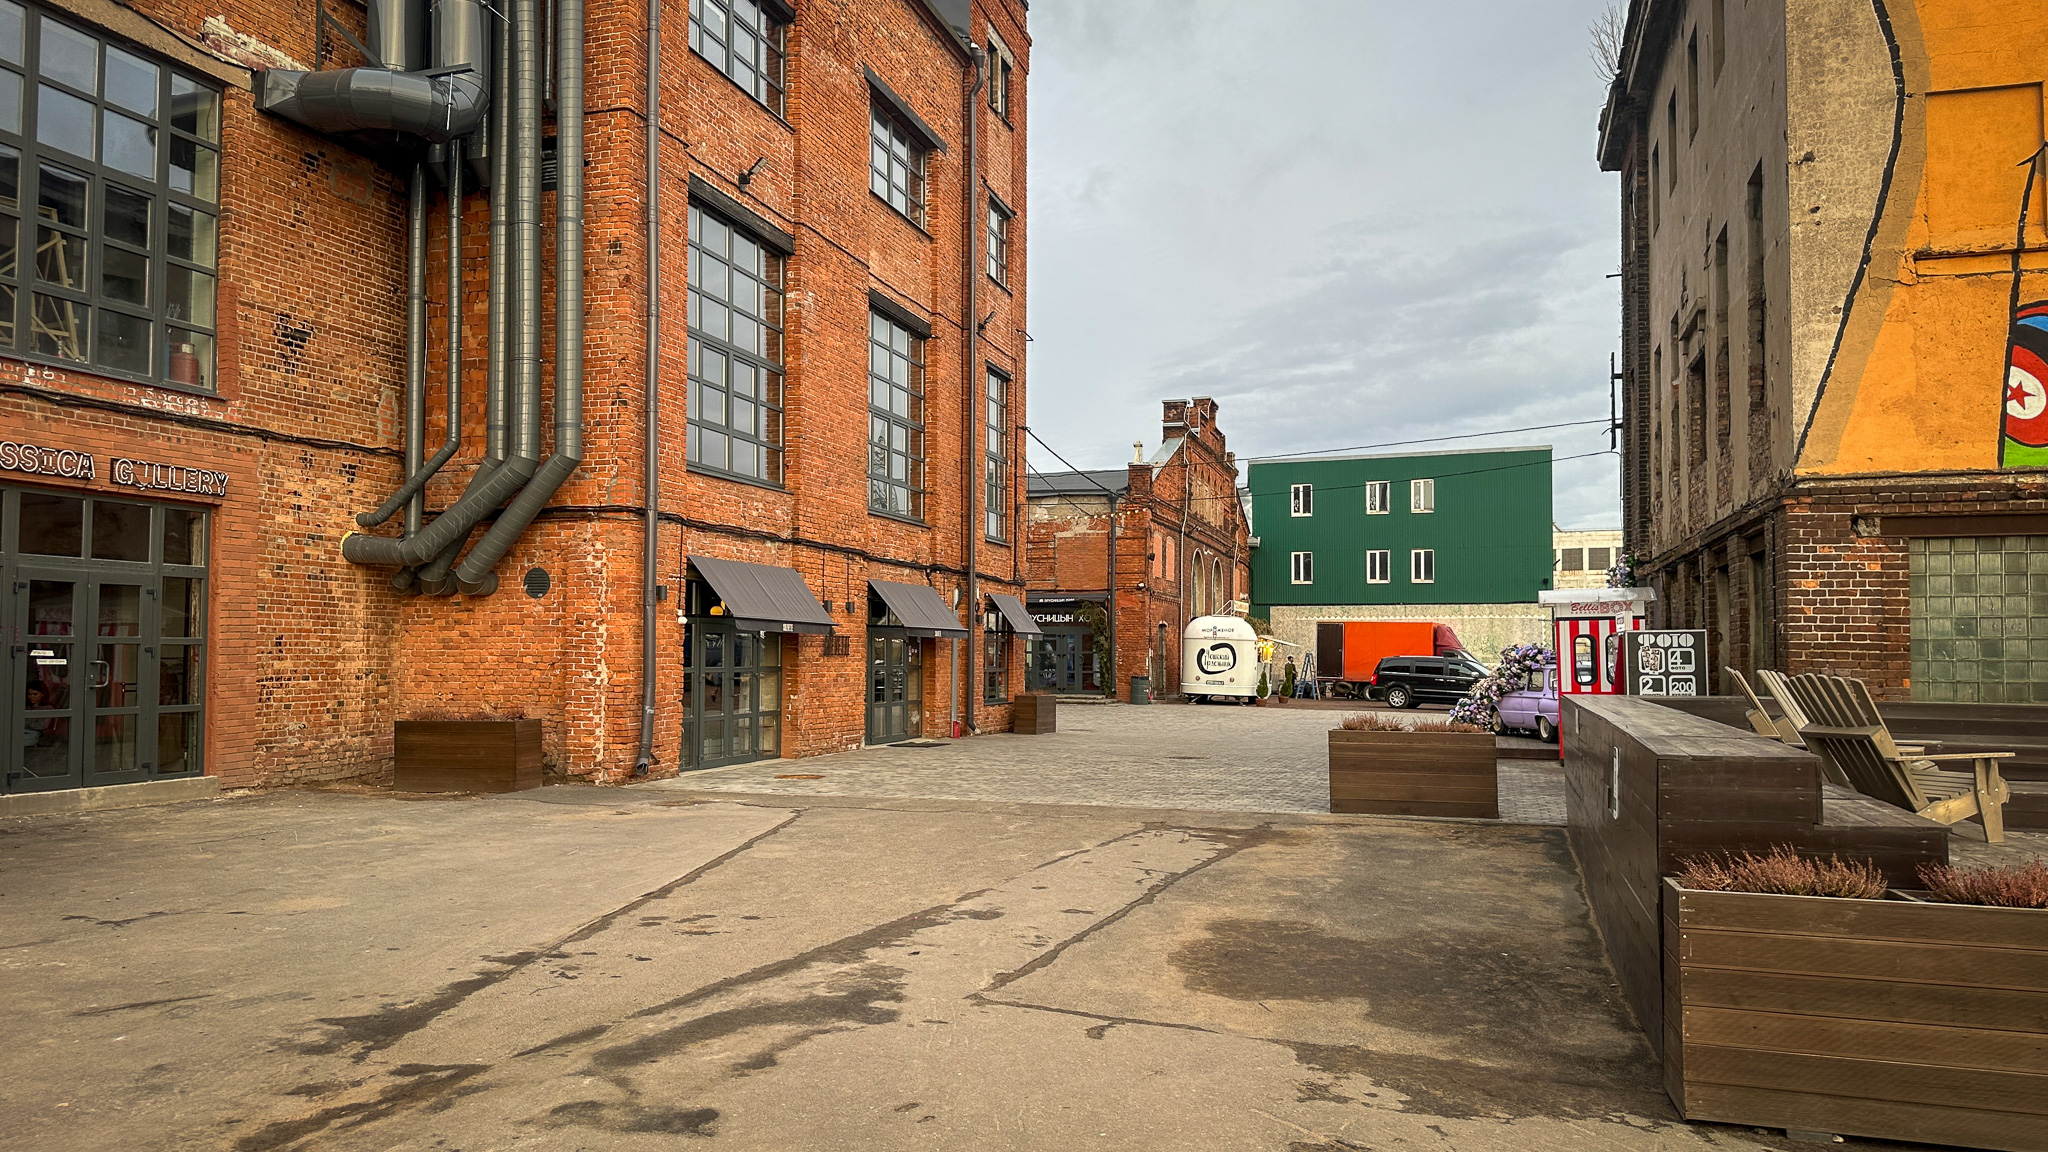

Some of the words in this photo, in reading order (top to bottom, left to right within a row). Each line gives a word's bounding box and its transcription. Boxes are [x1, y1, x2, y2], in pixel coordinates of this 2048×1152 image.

[115, 458, 230, 496] GLLERY
[1571, 602, 1599, 612] Bellis
[1600, 601, 1634, 614] BOX
[1029, 614, 1074, 623] УСНИЦЫН
[1637, 633, 1694, 648] ФОТО
[1670, 650, 1683, 665] 4
[1642, 678, 1653, 692] 2
[1672, 681, 1693, 692] 200
